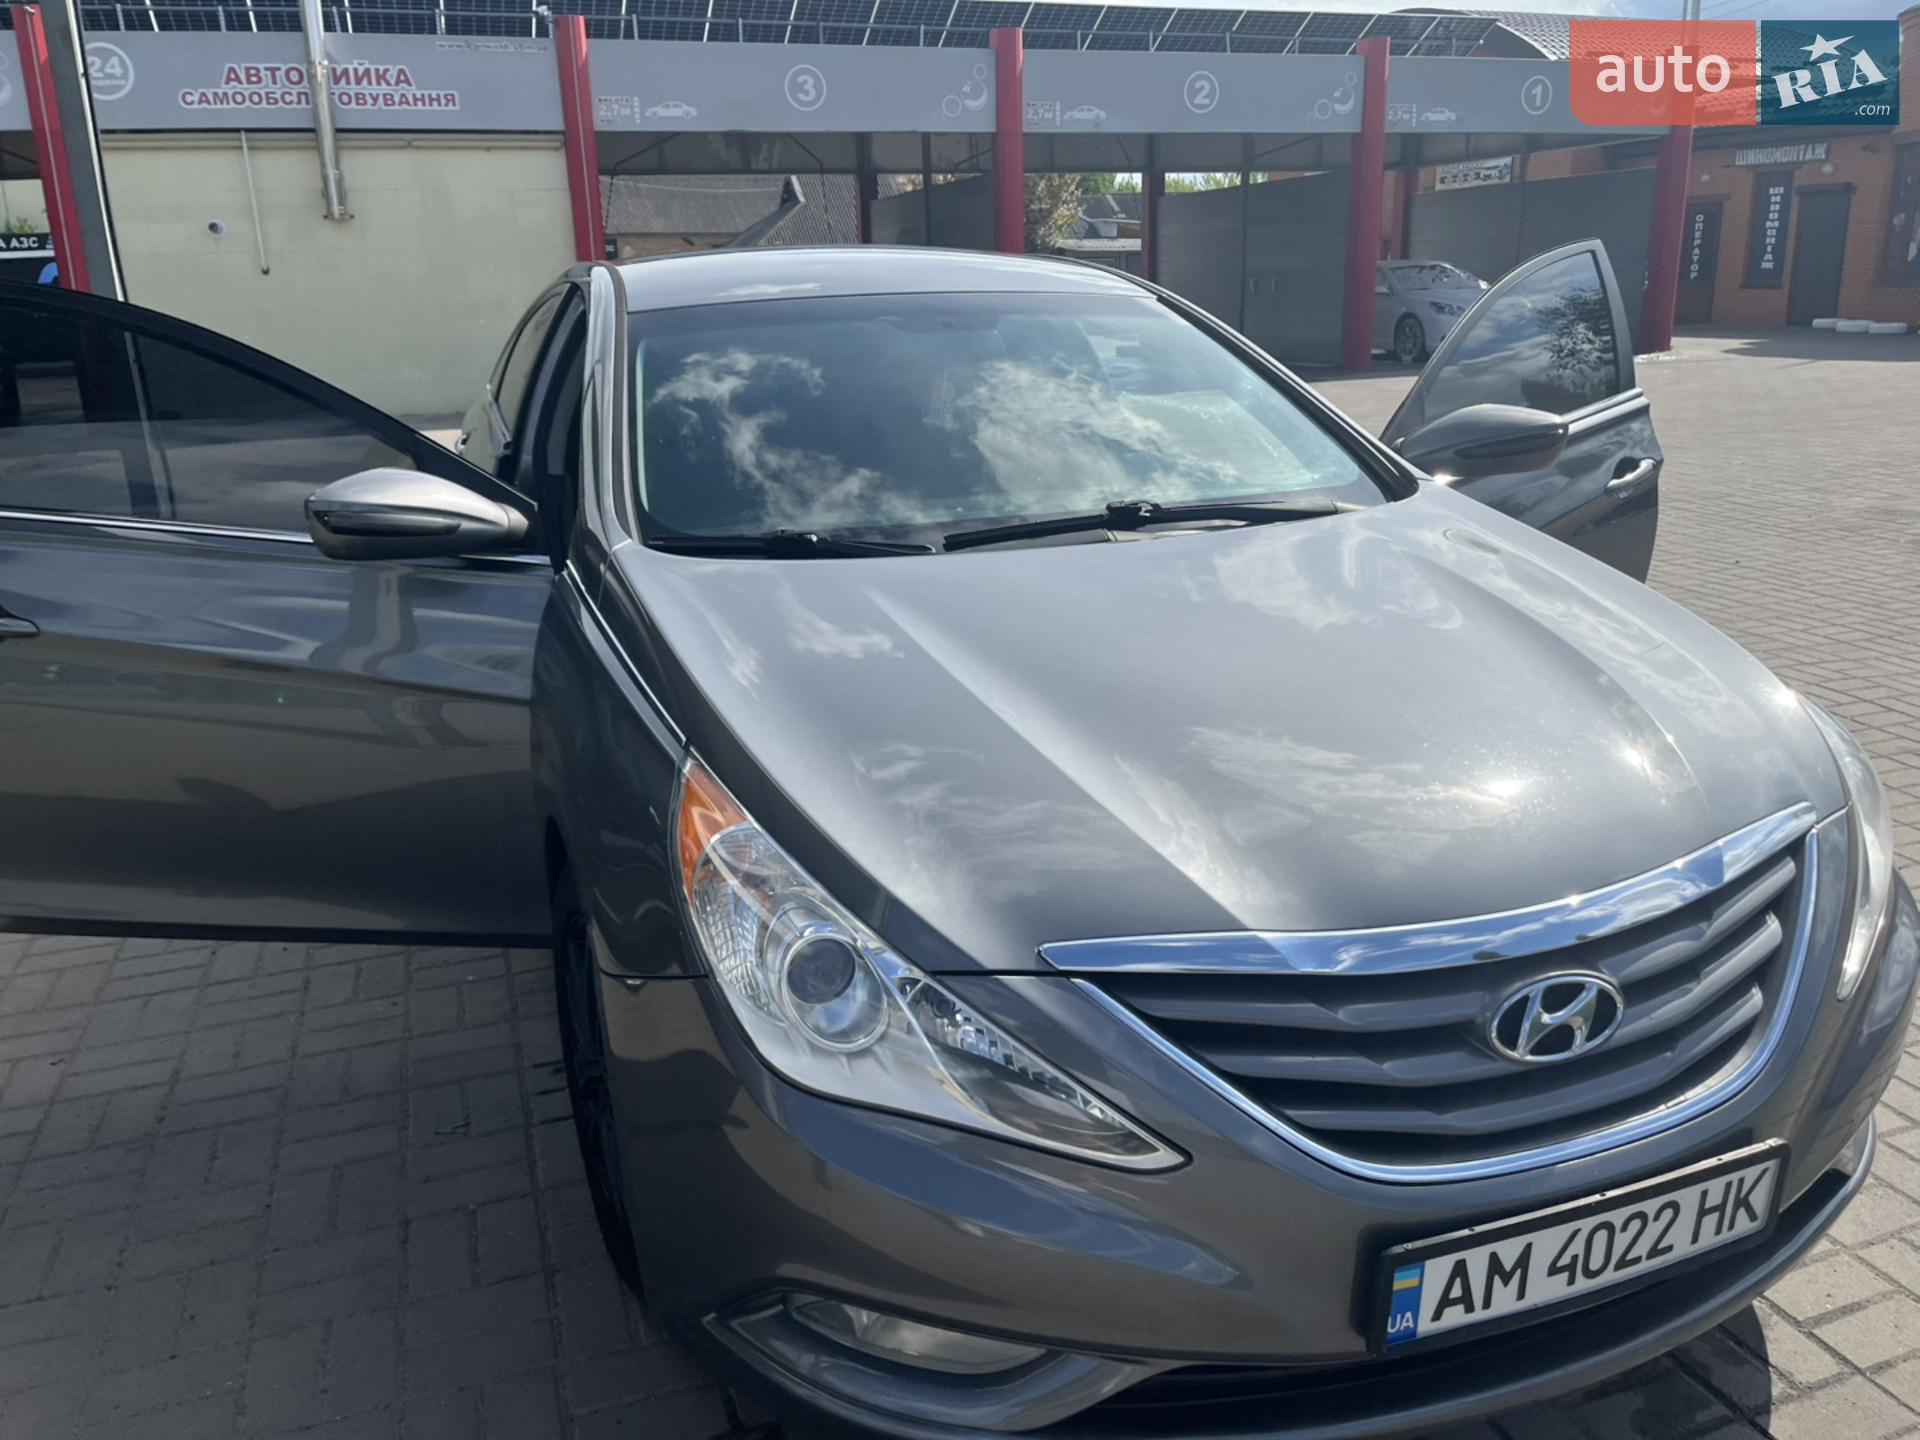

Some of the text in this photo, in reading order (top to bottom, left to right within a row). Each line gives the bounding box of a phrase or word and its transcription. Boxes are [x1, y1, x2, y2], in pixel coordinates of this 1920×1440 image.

[86, 56, 124, 77] 24
[222, 61, 417, 90] АВТОИЙКА
[179, 90, 459, 110] САМООБСЛОВУВАННЯ
[796, 75, 816, 101] 3
[1194, 80, 1211, 105] 2
[1531, 84, 1542, 107] 1
[1735, 143, 1827, 165] ШИНОМОНТАЖ
[1760, 186, 1784, 269] ШИНОМОНТАЖ
[10, 236, 39, 249] АЗС
[1690, 214, 1704, 279] ОПЕРАТОР
[1430, 1166, 1770, 1322] AM 4022 HK
[1387, 1311, 1414, 1333] UA
